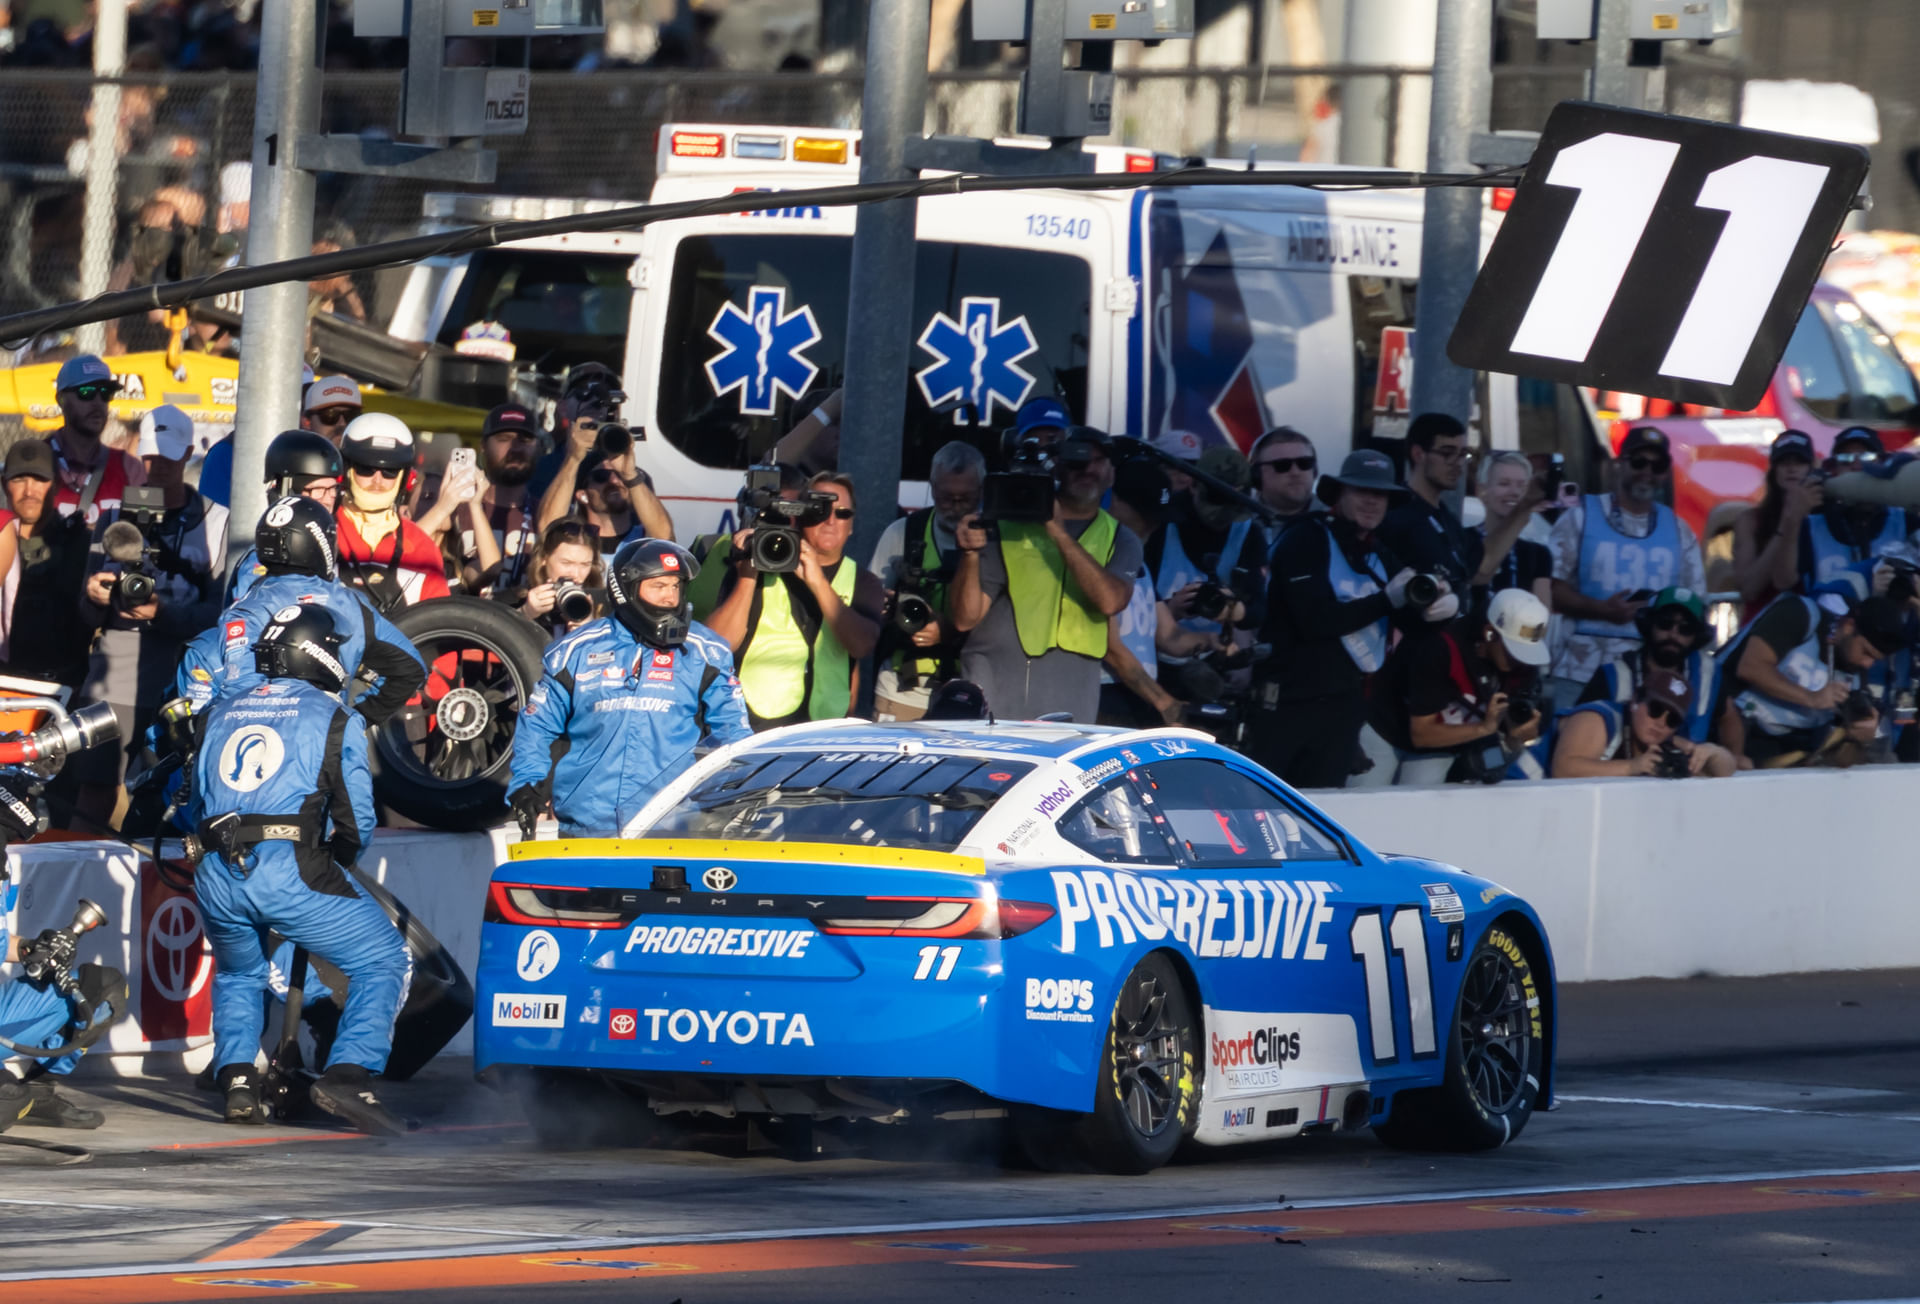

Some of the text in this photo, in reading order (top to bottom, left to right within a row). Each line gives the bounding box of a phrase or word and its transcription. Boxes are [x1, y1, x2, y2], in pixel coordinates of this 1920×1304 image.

[264, 133, 278, 166] 1
[1026, 214, 1091, 240] 13540
[1287, 220, 1398, 267] AMBULANCE
[1508, 132, 1831, 386] 11
[1591, 541, 1673, 592] 433
[263, 625, 286, 640] 11
[224, 709, 299, 721] progressive.com
[594, 696, 676, 713] PROGRESSIVE
[817, 751, 950, 765] HAMLIN
[1033, 778, 1075, 820] yahoo!
[1006, 817, 1037, 845] NATIONAL
[1259, 822, 1275, 853] TOYOTA
[622, 895, 825, 908] CAMRY
[1050, 871, 1335, 961] PROGRESSIVE
[624, 926, 815, 958] PROGRESSIVE
[912, 945, 963, 981] 11
[1026, 978, 1094, 1011] BOB'S
[1349, 906, 1439, 1064] 11
[498, 1002, 558, 1019] Mobil 1
[1026, 1009, 1058, 1021] Discount
[644, 1009, 815, 1046] TOYOTA
[1228, 1070, 1279, 1086] HAIRCUTS
[1223, 1107, 1247, 1128] Mobil
